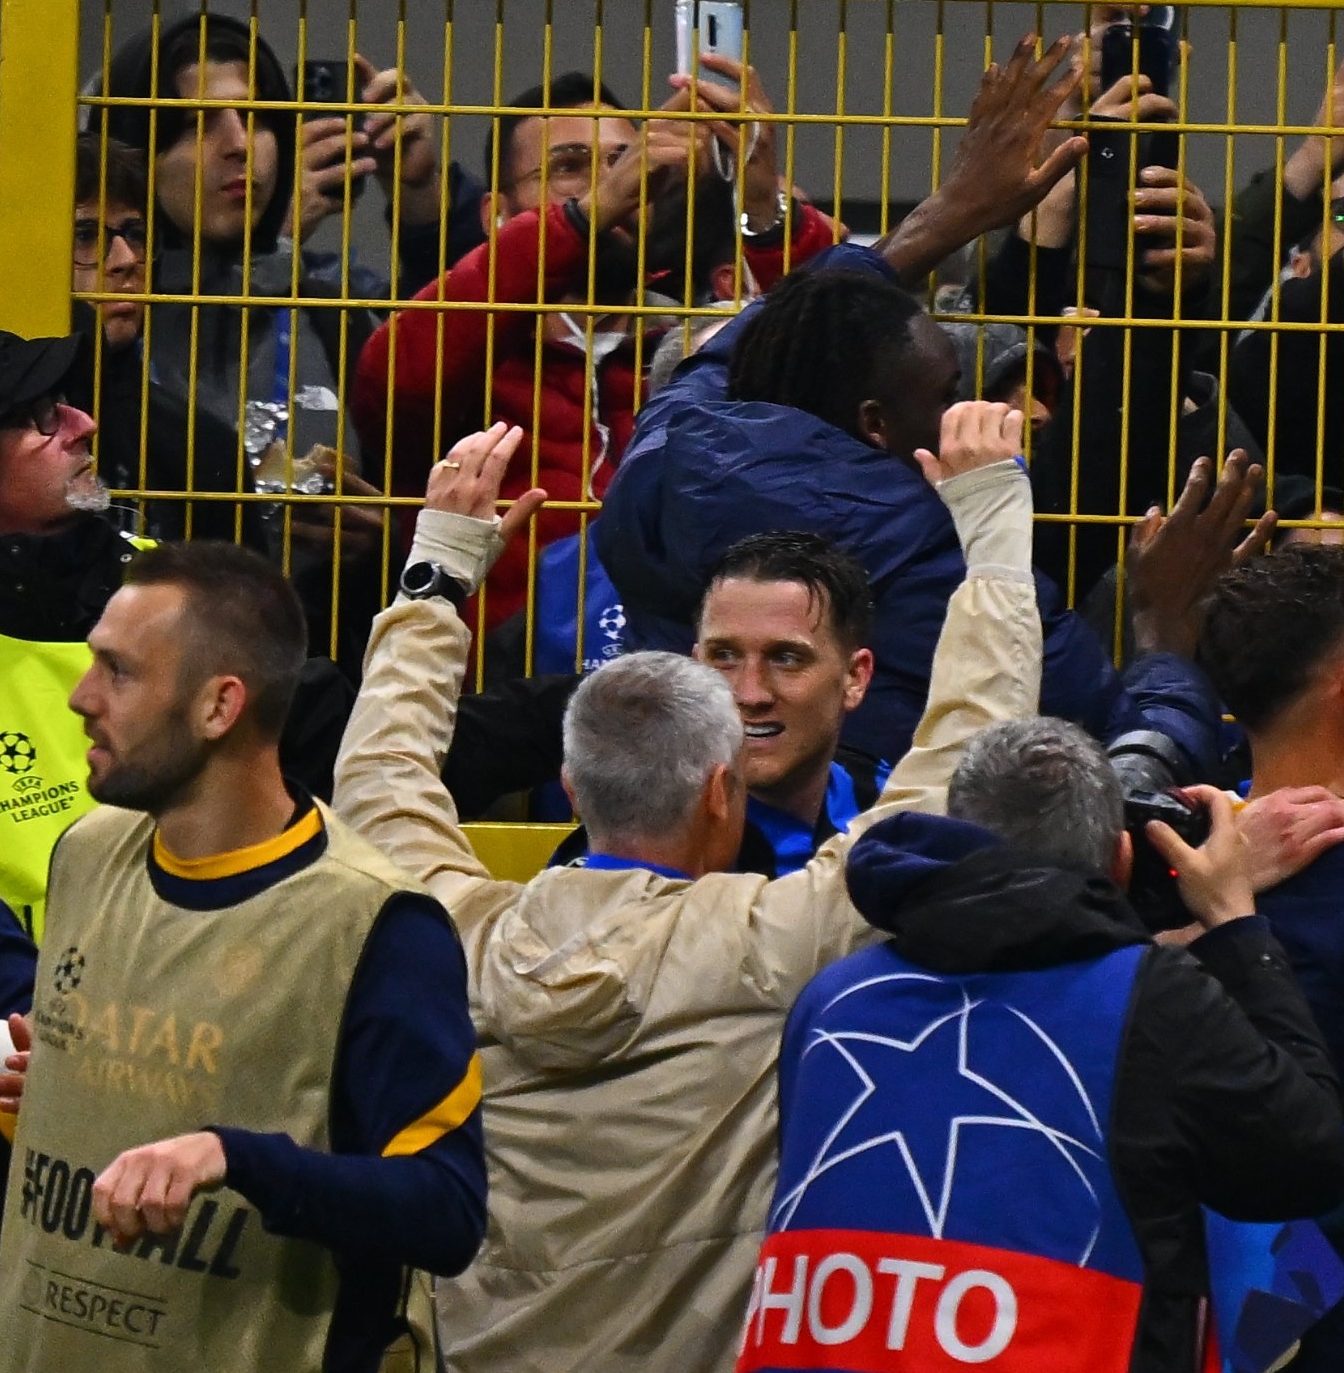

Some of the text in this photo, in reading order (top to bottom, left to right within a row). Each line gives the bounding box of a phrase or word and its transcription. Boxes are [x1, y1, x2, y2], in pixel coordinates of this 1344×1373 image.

[0, 780, 80, 814] HAMPIONS
[45, 1280, 166, 1336] RESPECT
[738, 1251, 1018, 1364] HOTO
